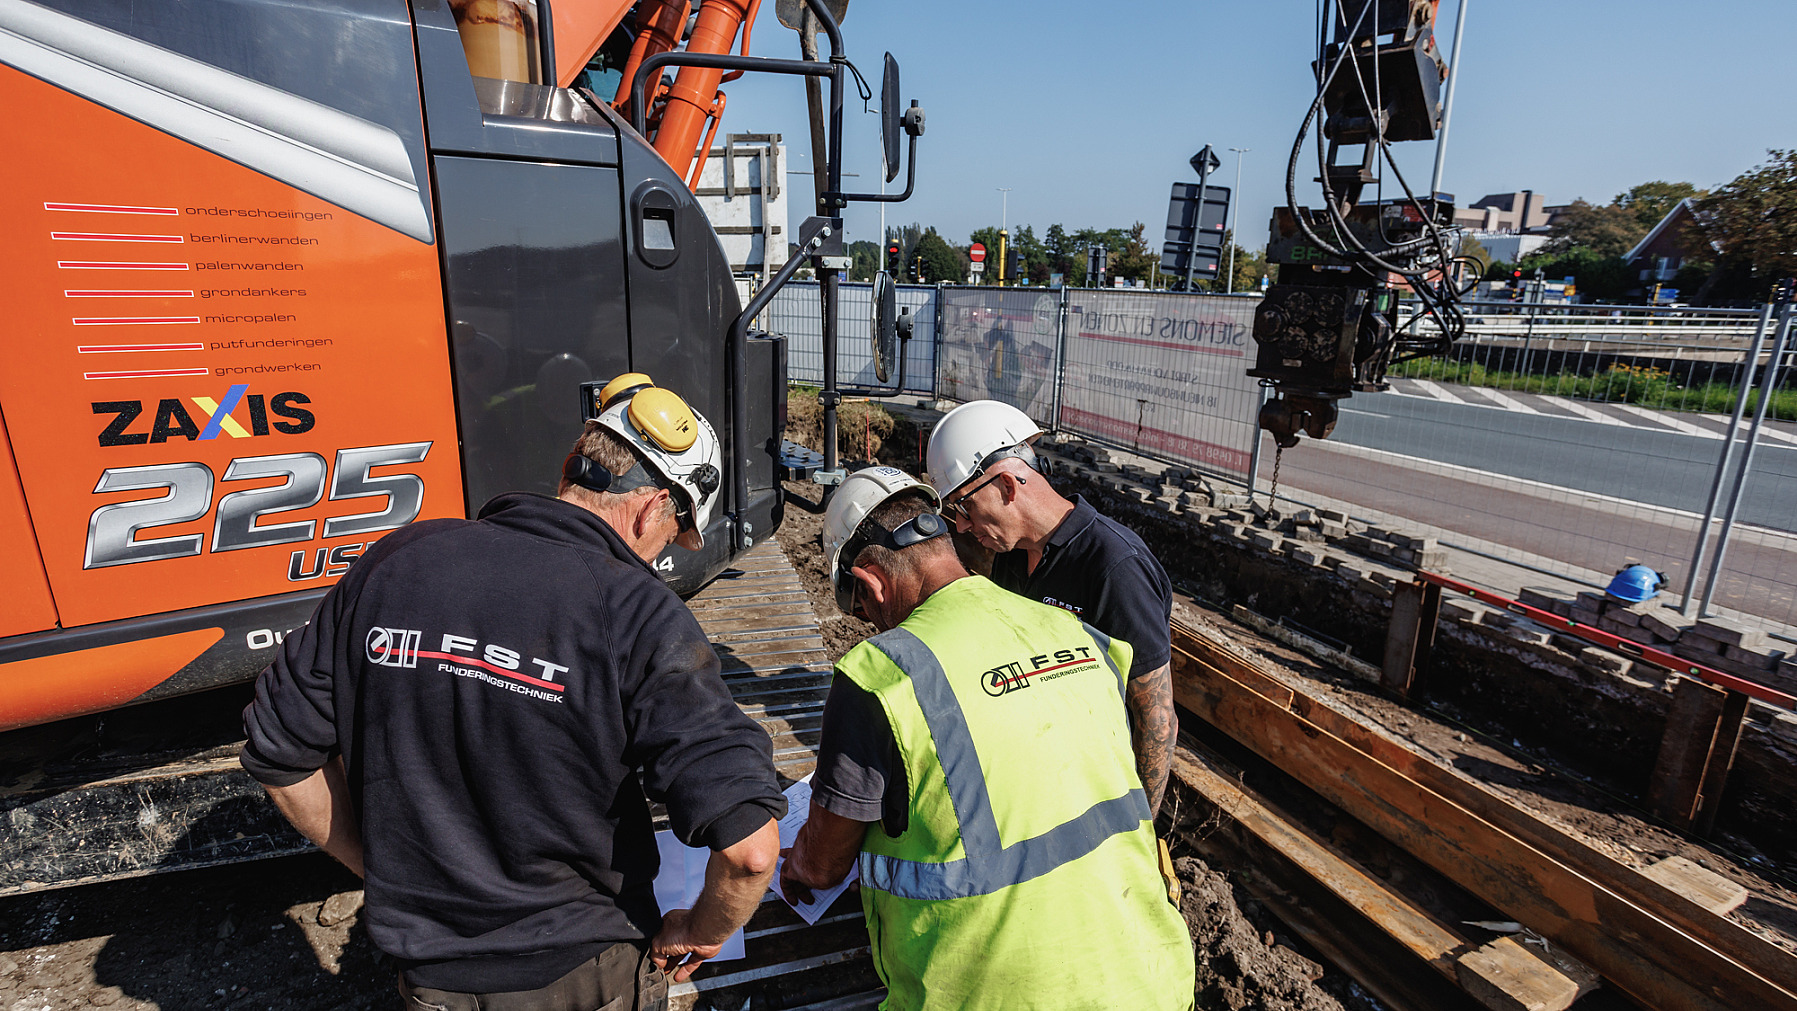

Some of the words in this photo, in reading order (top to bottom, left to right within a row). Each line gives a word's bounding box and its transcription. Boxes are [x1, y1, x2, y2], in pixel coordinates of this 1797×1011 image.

[185, 206, 333, 222] onderschoeiingen
[189, 233, 319, 246] berlinerwanden
[195, 260, 304, 272] palenwanden
[200, 287, 307, 299] grondankers
[205, 312, 297, 324] micropalen
[210, 337, 333, 351] putfunderingen
[215, 362, 322, 377] grondwerken
[91, 383, 316, 447] ZAXIS
[82, 441, 435, 570] 225
[287, 541, 377, 582] US
[440, 633, 570, 682] FST
[1029, 646, 1090, 670] FST
[1039, 664, 1101, 683] FUNDERINGSTECHNIEK
[437, 663, 563, 703] FUNDERINGSTECHNIEK
